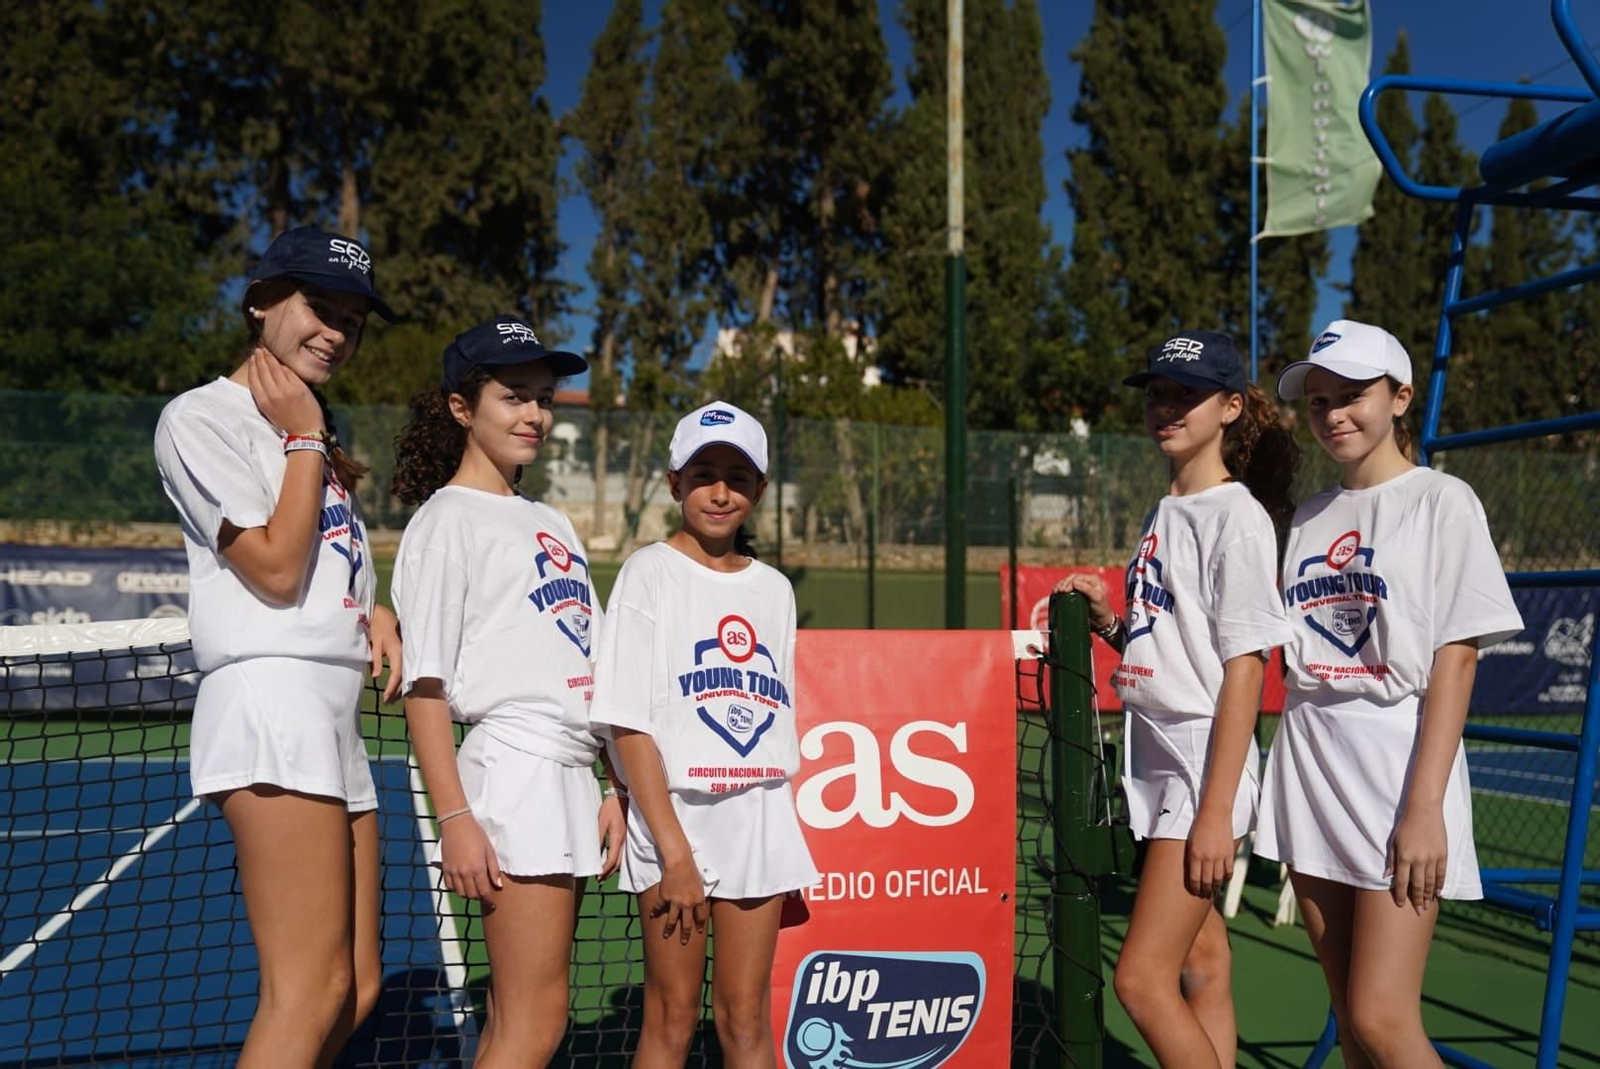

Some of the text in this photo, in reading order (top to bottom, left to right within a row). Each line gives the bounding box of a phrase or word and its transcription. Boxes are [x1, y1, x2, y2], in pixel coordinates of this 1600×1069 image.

[329, 238, 372, 269] SER
[1162, 337, 1205, 354] SER
[1169, 350, 1201, 363] playa
[1335, 544, 1355, 557] as
[1286, 571, 1388, 607] YOUNG TOUR
[727, 631, 747, 646] as
[678, 667, 791, 709] YOUNG TOUR
[696, 690, 779, 709] UNIVERSAL TENIS
[688, 767, 727, 778] CIRCUITO
[728, 767, 764, 778] NACIONAL
[796, 720, 975, 829] as
[804, 867, 989, 902] EDIO OFICIAL
[806, 961, 880, 1011] ibp
[866, 995, 975, 1040] TENIS
